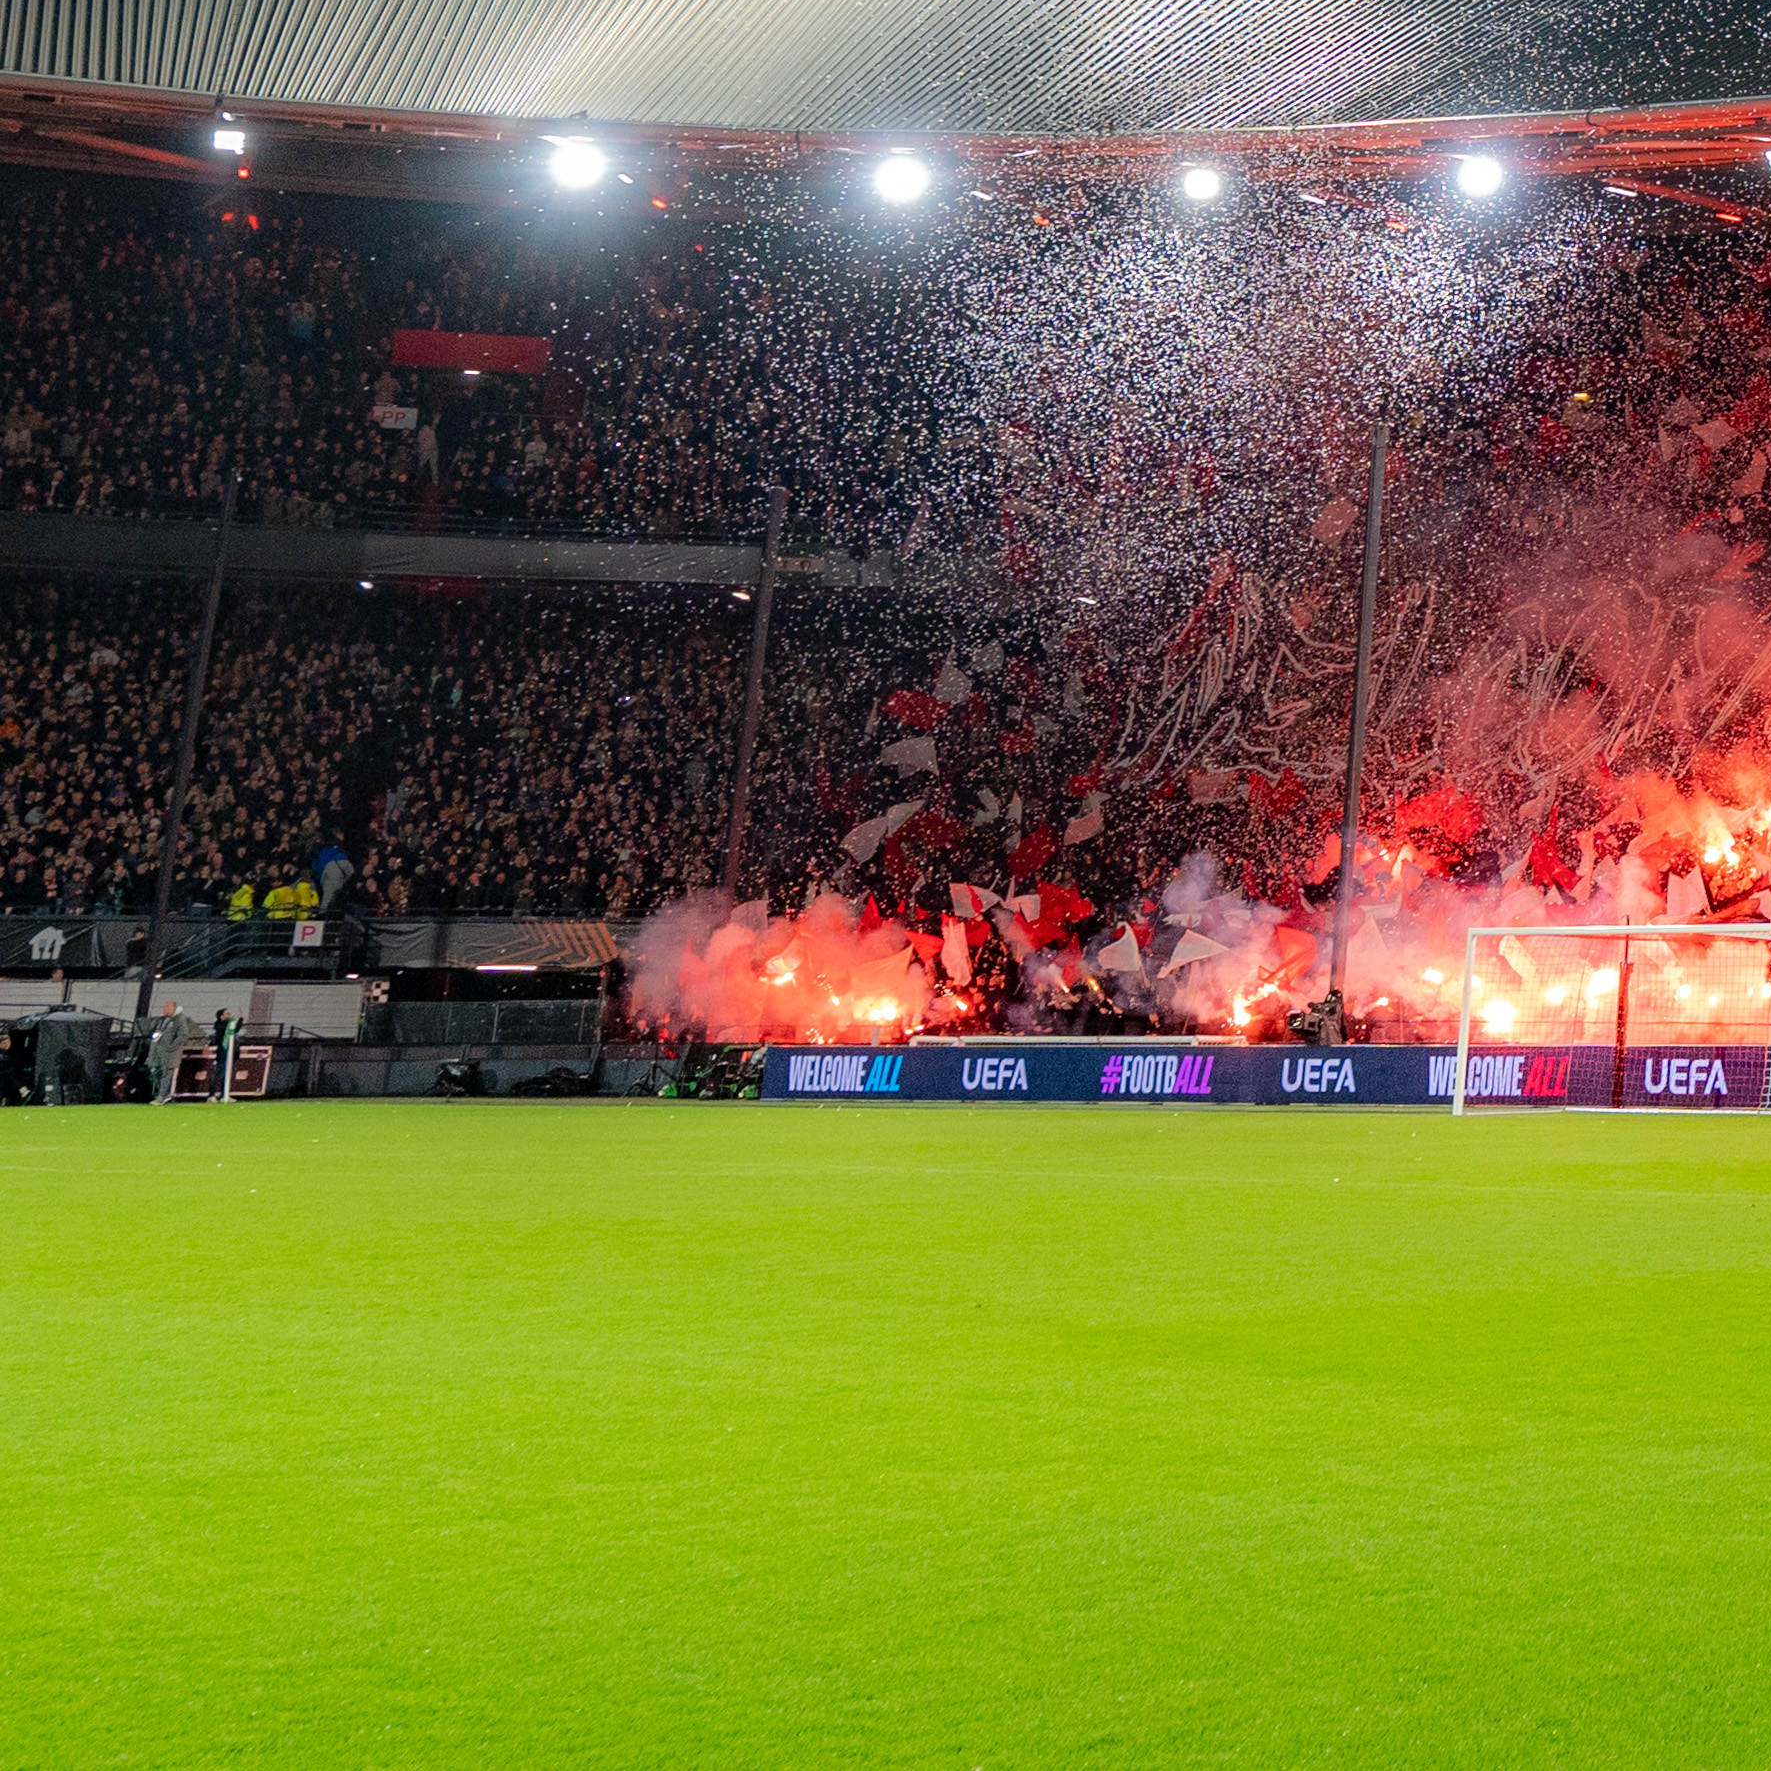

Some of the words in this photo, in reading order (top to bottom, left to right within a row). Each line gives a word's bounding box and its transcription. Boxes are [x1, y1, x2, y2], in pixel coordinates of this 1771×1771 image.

[300, 925, 316, 942] P
[788, 1055, 863, 1092] WELCOME
[866, 1054, 903, 1092] ALL
[961, 1057, 1028, 1091] UEFA
[1099, 1054, 1215, 1095] #FOOTBALL
[1281, 1058, 1356, 1093] UEFA
[1428, 1056, 1524, 1097] WECOME
[1525, 1056, 1569, 1097] ALL
[1642, 1058, 1729, 1096] UEFA
